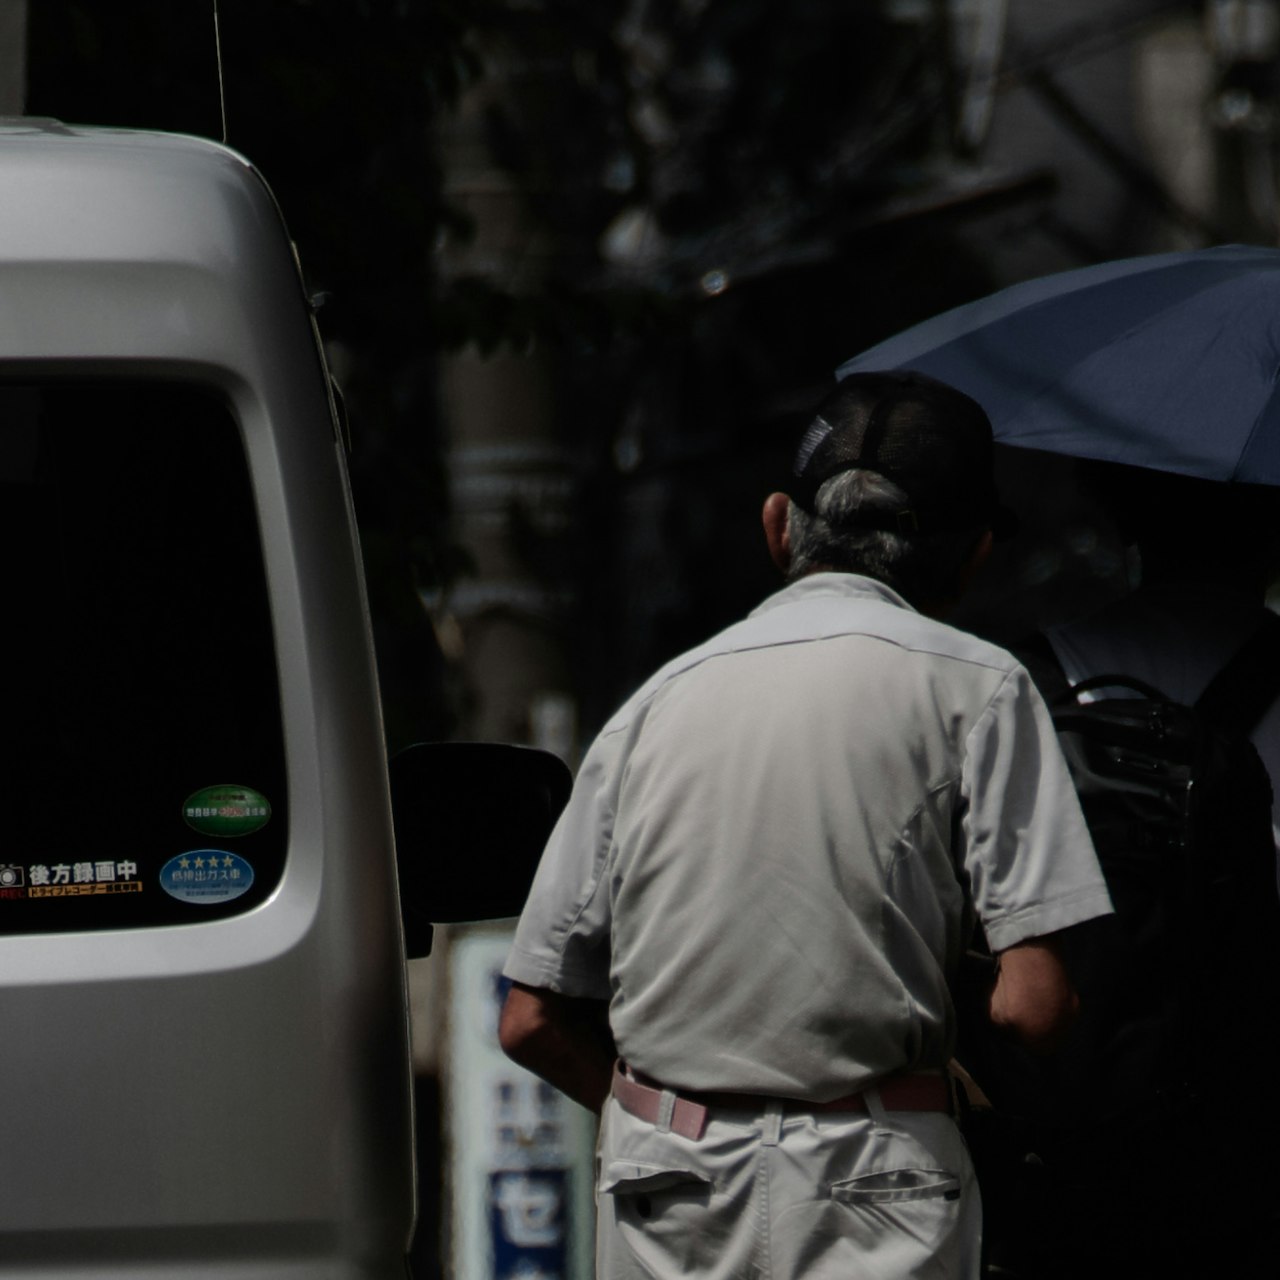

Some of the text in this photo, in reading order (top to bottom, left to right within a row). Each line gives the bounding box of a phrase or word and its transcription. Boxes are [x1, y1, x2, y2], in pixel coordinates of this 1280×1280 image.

[29, 861, 138, 886] 後方録画中
